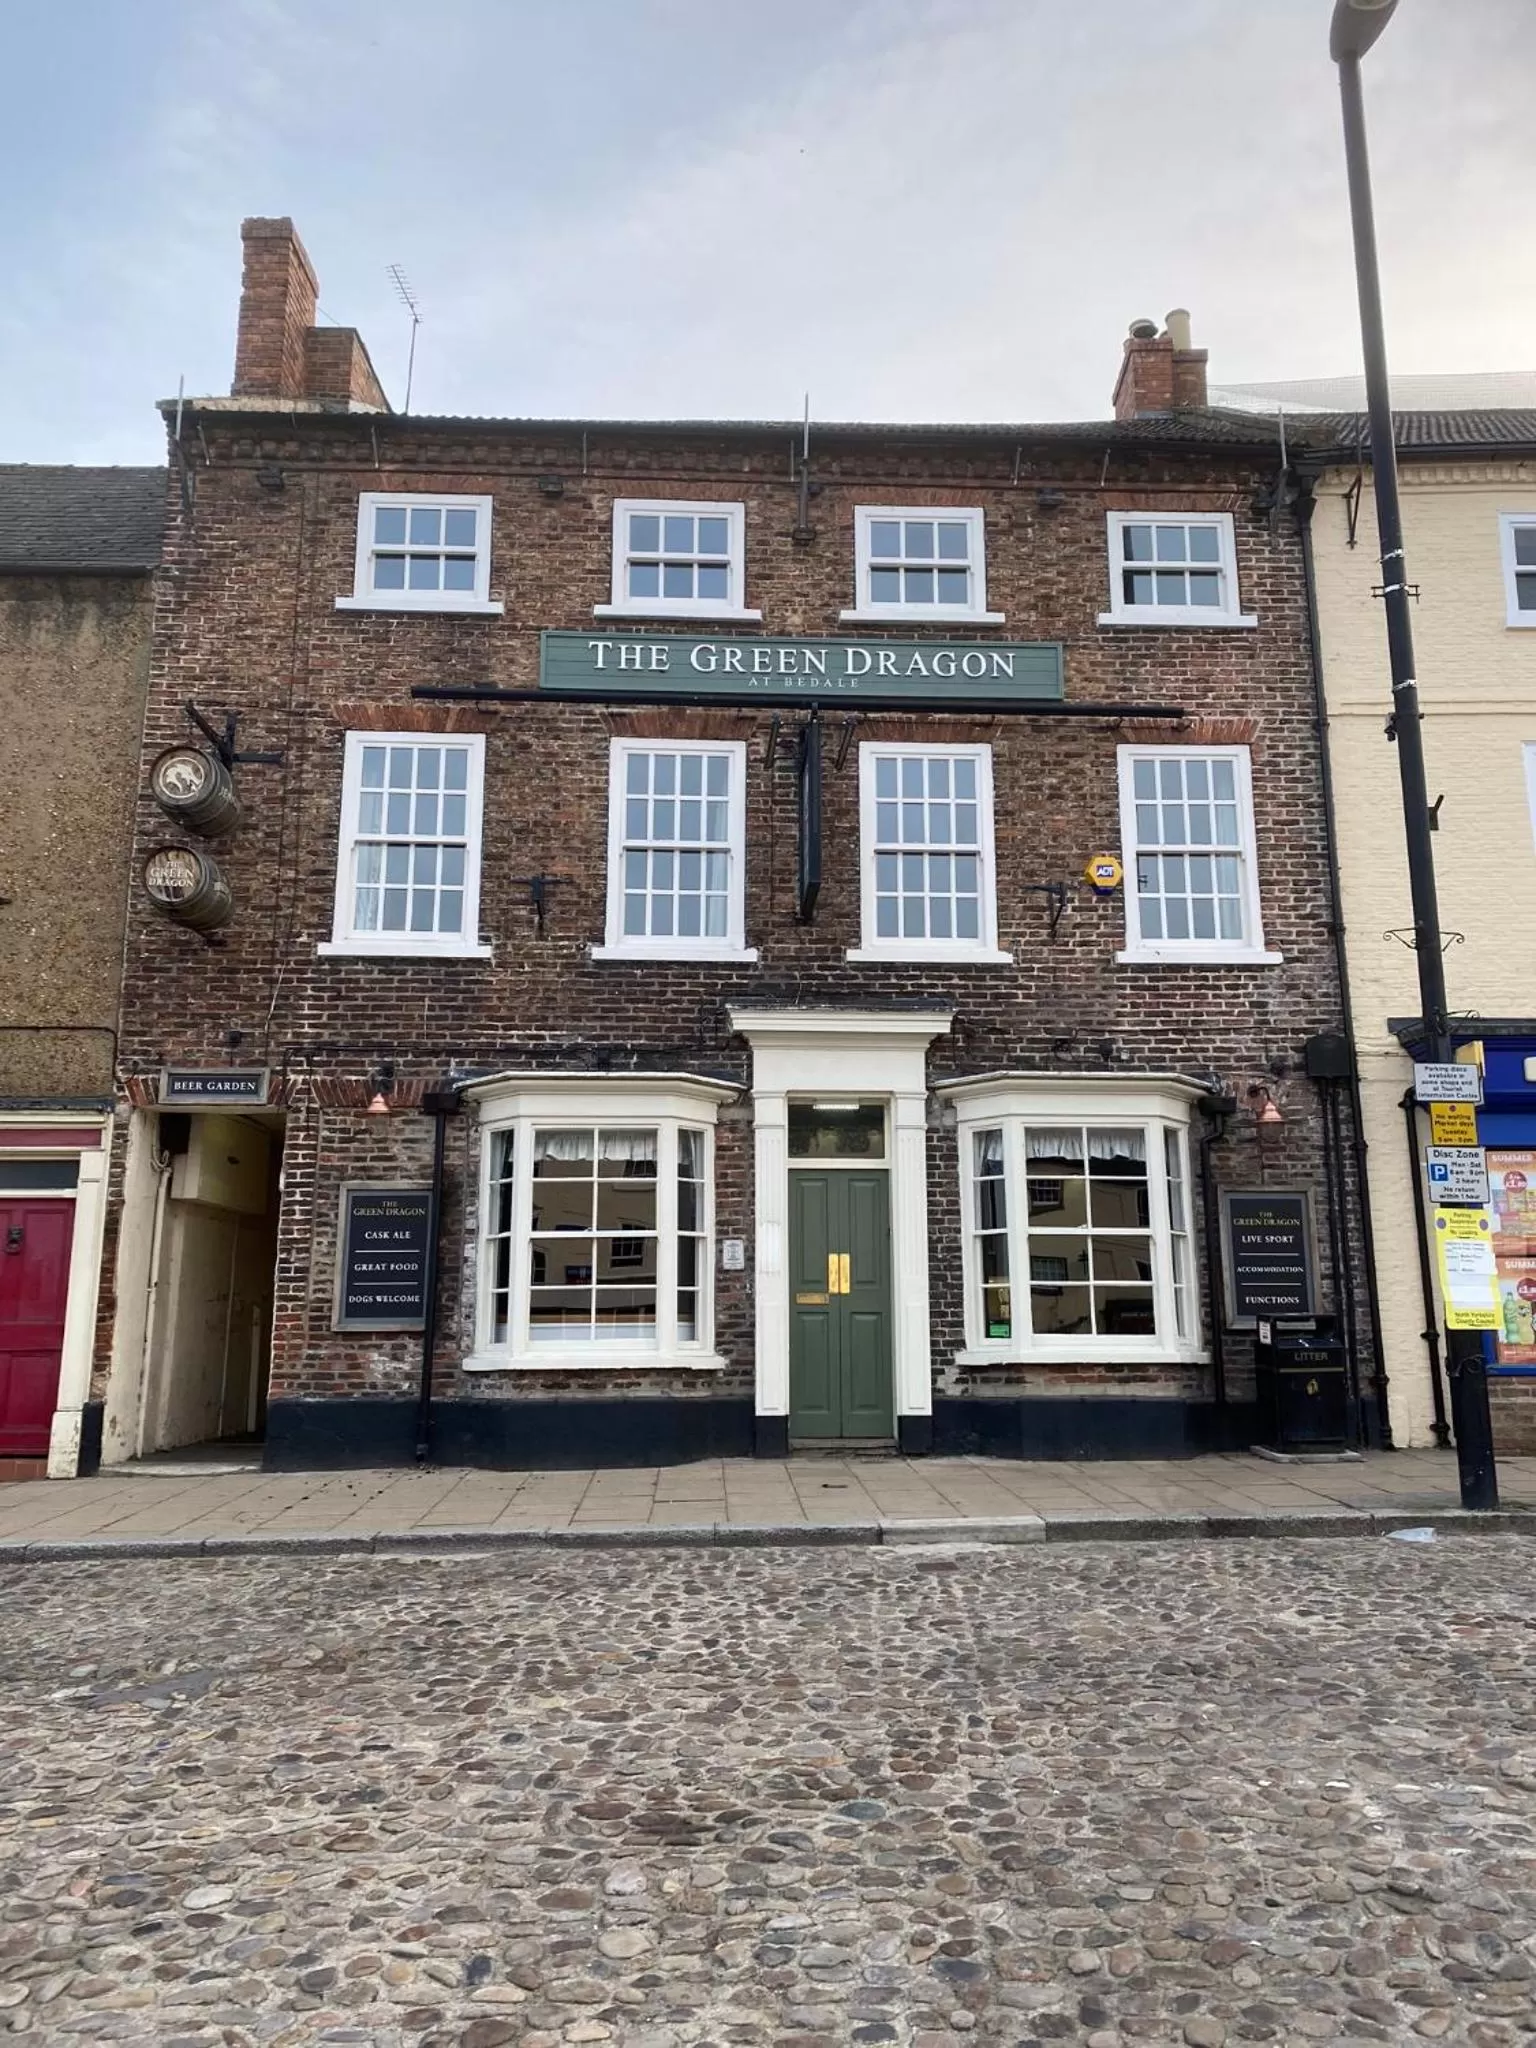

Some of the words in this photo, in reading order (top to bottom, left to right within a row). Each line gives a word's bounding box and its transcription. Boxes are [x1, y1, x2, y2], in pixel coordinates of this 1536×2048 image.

[588, 641, 670, 671] THE
[690, 644, 829, 674] GREEN
[844, 647, 1016, 678] DRAGON
[748, 677, 771, 687] AT
[785, 677, 859, 688] BEDALE
[150, 867, 194, 879] GREEN
[1096, 866, 1113, 876] ADT
[148, 877, 194, 888] DRAGON
[174, 1082, 203, 1091] BEER
[207, 1081, 256, 1091] GARDEN
[1433, 1149, 1454, 1158] Disc
[1456, 1149, 1480, 1159] Zone
[1434, 1165, 1446, 1180] P
[353, 1207, 384, 1217] GREEN
[385, 1207, 426, 1217] DRAGON
[1233, 1218, 1262, 1226] GREEN
[1263, 1218, 1301, 1227] DRAGON
[365, 1231, 389, 1240] CASK
[392, 1231, 412, 1240] ALE
[1241, 1235, 1263, 1244] LIVE
[1264, 1235, 1295, 1244] SPORT
[354, 1263, 386, 1272] GREAT
[389, 1262, 419, 1272] FOOD
[348, 1295, 374, 1304] DOGS
[375, 1294, 421, 1303] WELCOME
[1245, 1296, 1300, 1305] FUNCTIONS
[1471, 1311, 1495, 1319] Yorkshire
[1455, 1318, 1473, 1326] County
[1294, 1351, 1329, 1361] LITTER
